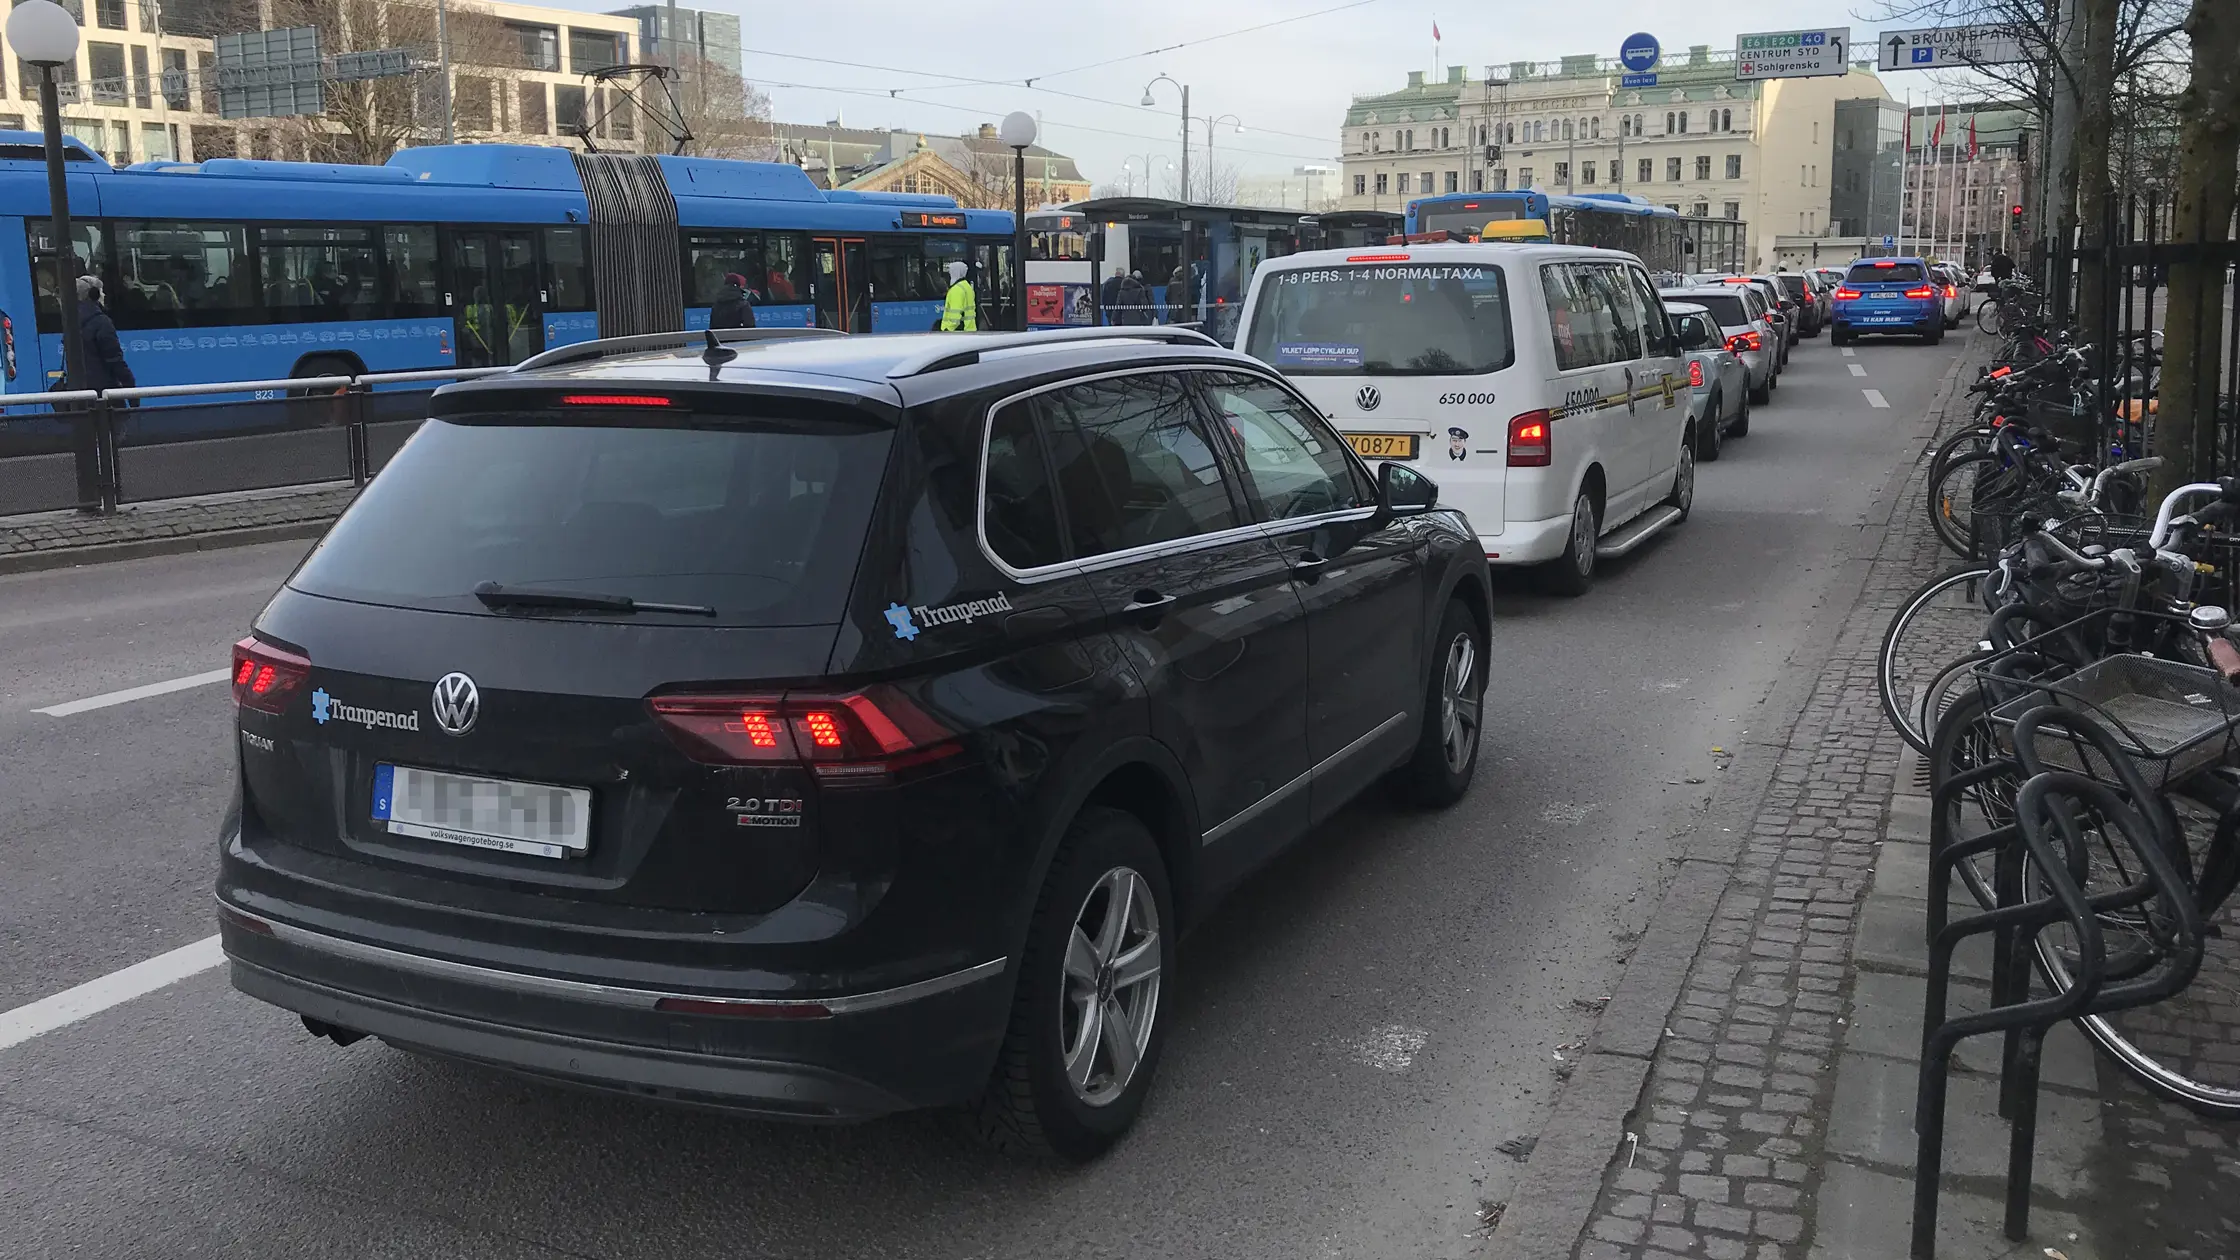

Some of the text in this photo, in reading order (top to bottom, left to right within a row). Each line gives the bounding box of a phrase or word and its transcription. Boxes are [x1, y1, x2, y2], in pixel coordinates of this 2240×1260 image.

[1747, 34, 1822, 47] E6 E20 40
[1740, 47, 1820, 59] CENTRUM SYD
[1757, 60, 1820, 72] Sahlgrenska
[1624, 76, 1655, 84] Även taxi
[1060, 217, 1071, 228] 16
[1278, 267, 1484, 285] 1-8 PERS. 1-4 NORMALTAXA
[1281, 347, 1303, 355] VILKET
[1320, 347, 1345, 355] CYKLAR
[1345, 347, 1359, 355] DU?
[255, 389, 274, 400] 823
[1439, 392, 1495, 405] 650 000
[1346, 436, 1405, 454] Y087 T
[912, 590, 1013, 628] Tranpenad
[330, 698, 419, 732] Tranpenad
[242, 730, 274, 752] TIGUAN
[379, 798, 387, 811] S
[764, 799, 803, 813] TDI
[430, 830, 515, 850] volkswagengoteborg.se
